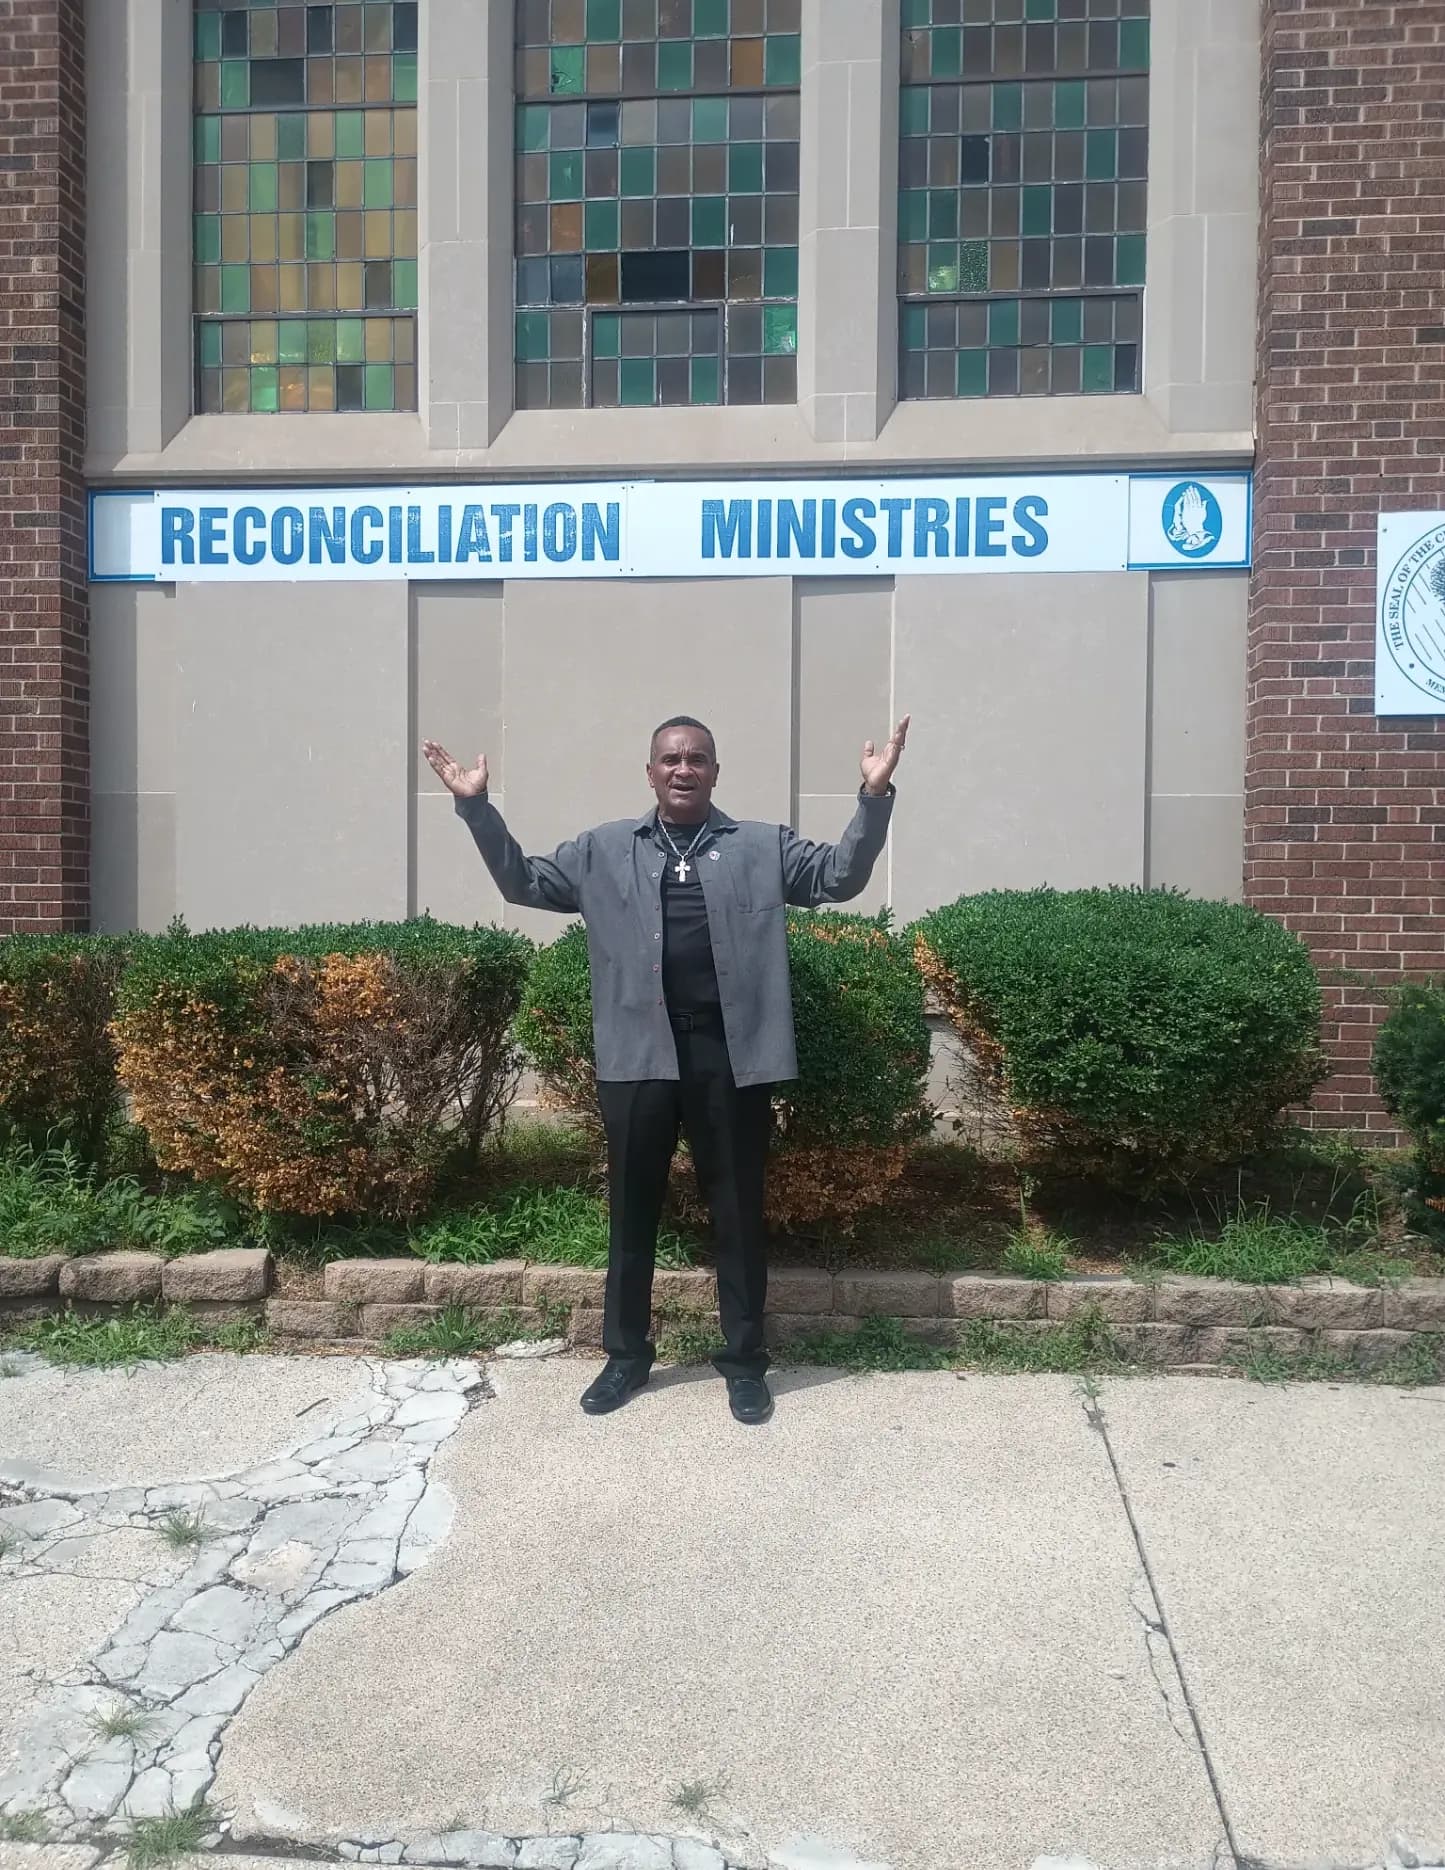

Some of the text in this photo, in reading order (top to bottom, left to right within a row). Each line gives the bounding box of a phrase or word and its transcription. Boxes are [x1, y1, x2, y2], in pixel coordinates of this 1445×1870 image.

[161, 495, 1049, 565] RECONCILIATION MINISTRIES
[1409, 540, 1435, 563] THE
[1397, 563, 1411, 582] OF
[1389, 586, 1404, 619] SEAL
[1390, 622, 1404, 650] THE
